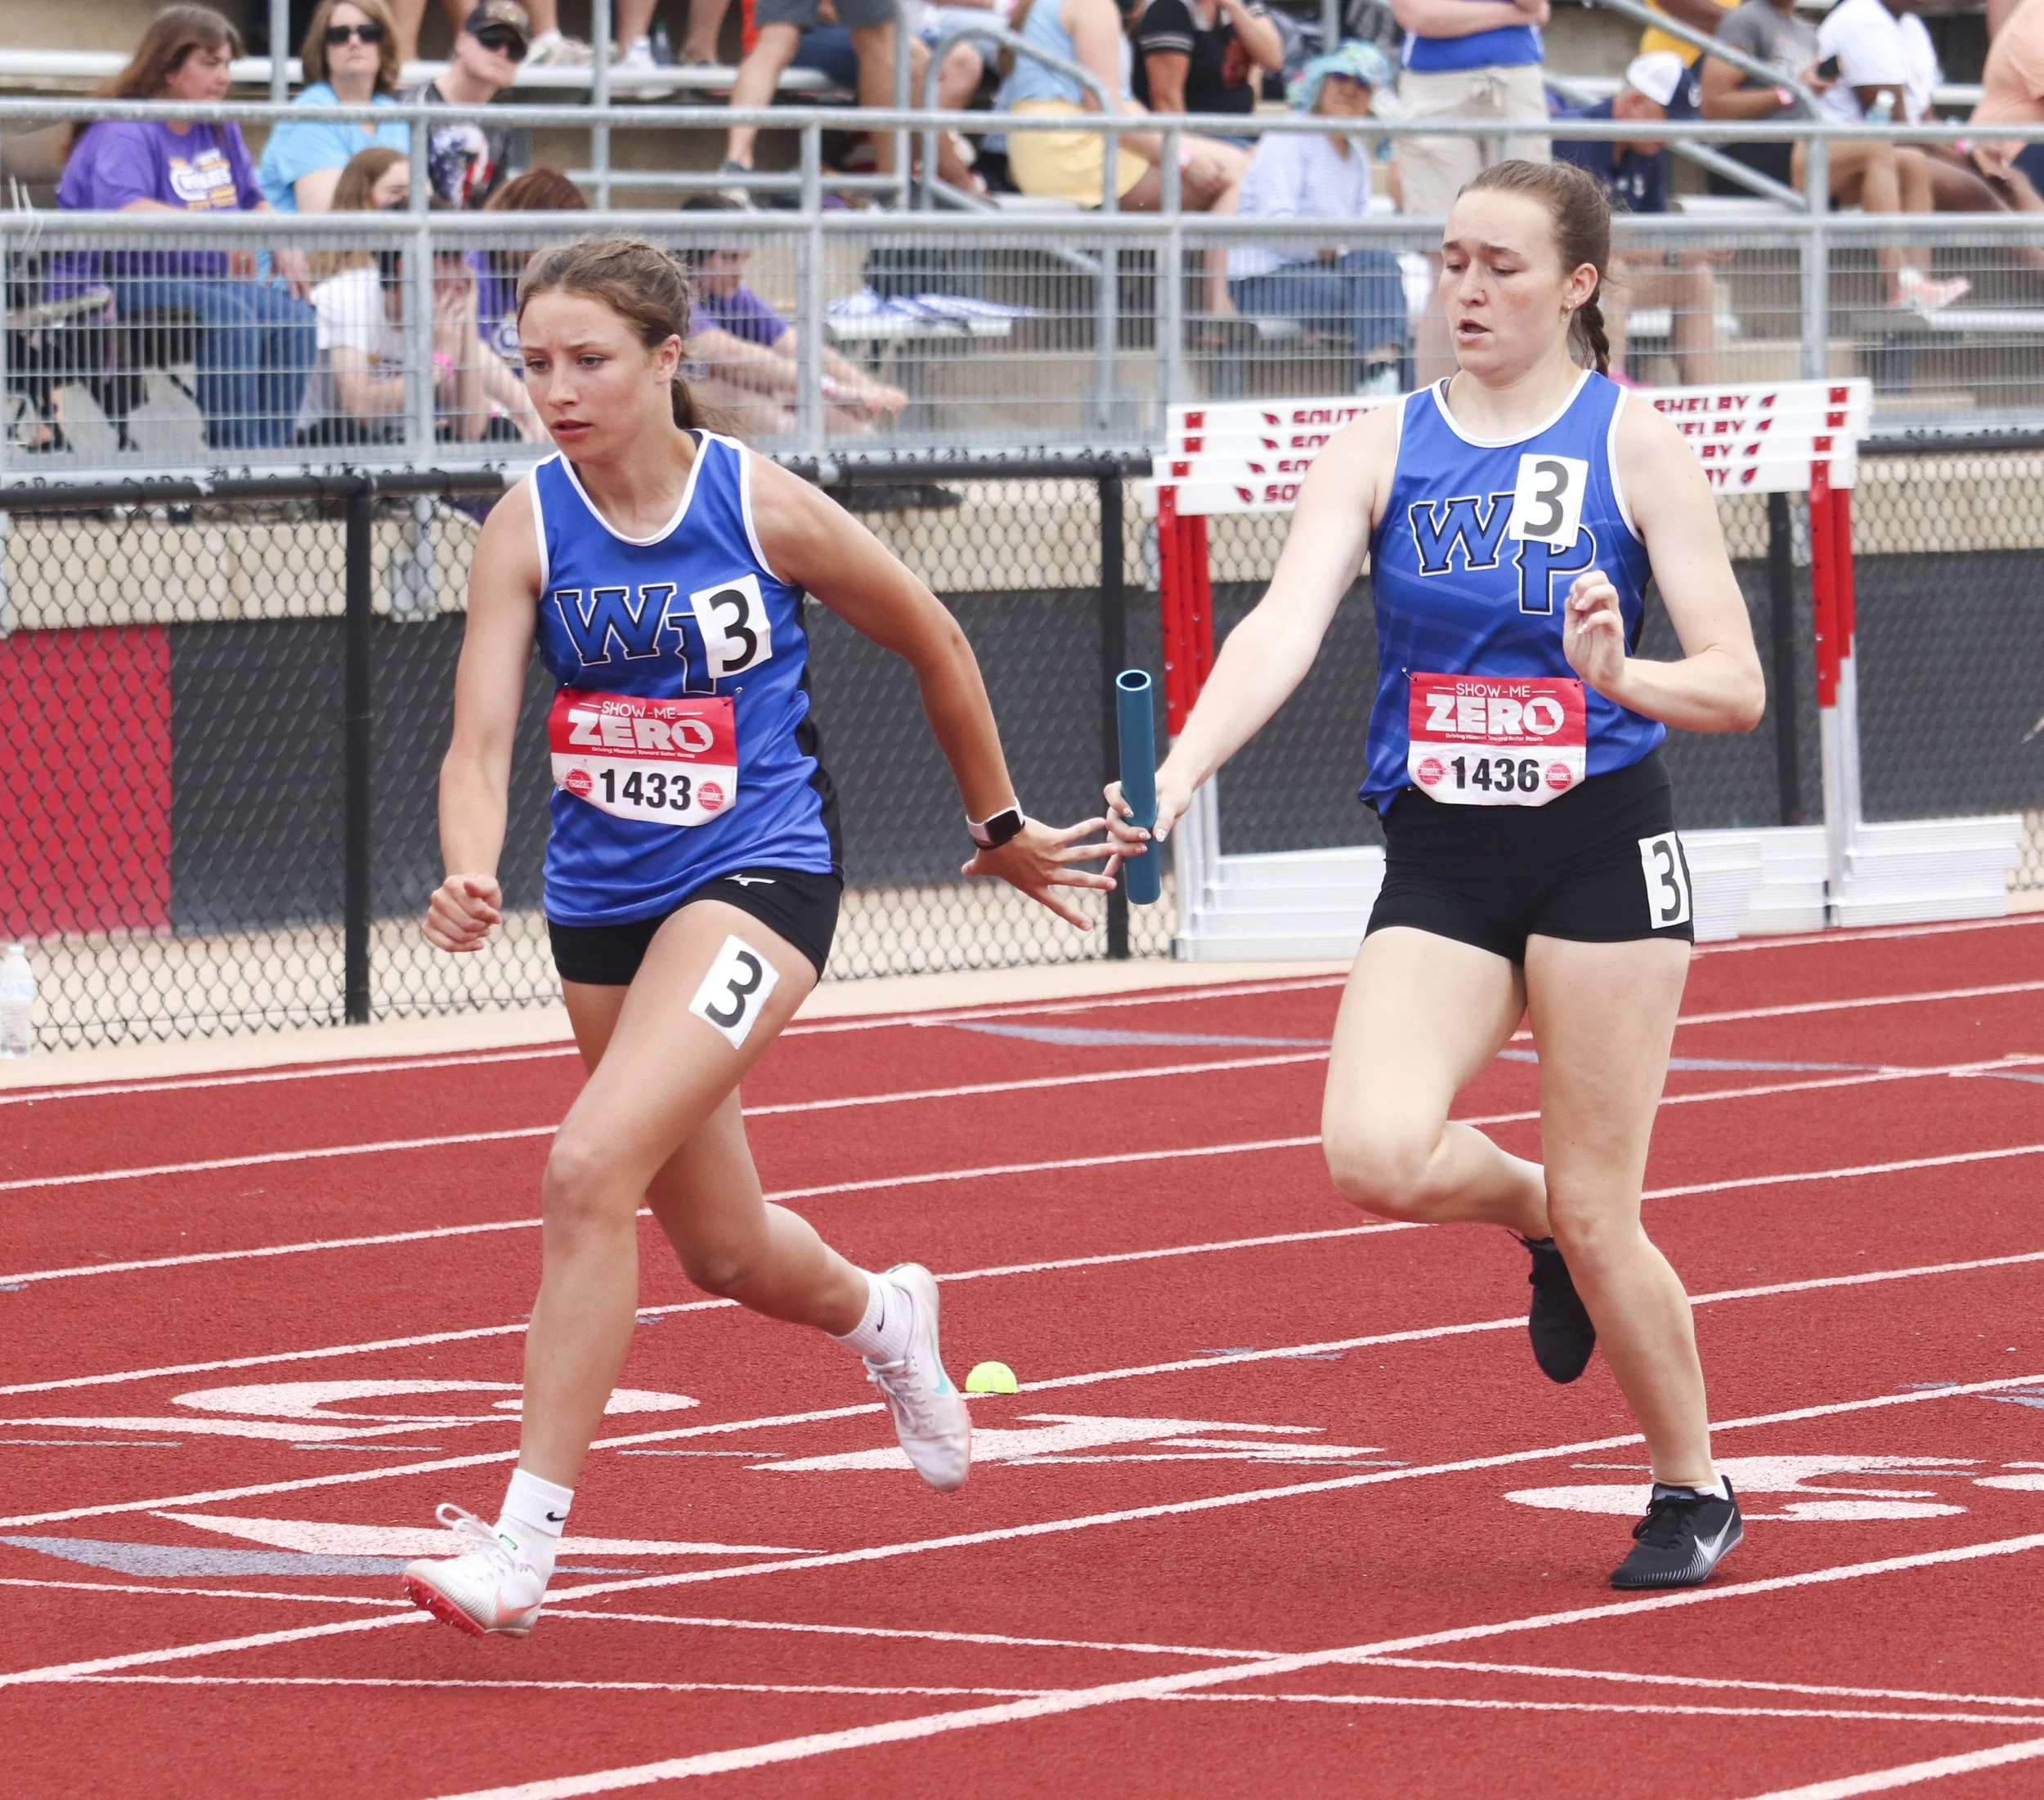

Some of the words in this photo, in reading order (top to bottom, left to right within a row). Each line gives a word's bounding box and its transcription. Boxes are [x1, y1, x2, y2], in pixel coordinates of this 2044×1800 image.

[1293, 408, 1378, 424] SOUT
[1652, 396, 1750, 413] SHELBY
[1676, 420, 1746, 436] ELBY
[1523, 460, 1569, 537] 3
[709, 589, 758, 673] 3
[601, 701, 676, 720] SHOW-ME
[1456, 683, 1531, 697] SHOW-ME
[567, 708, 715, 753] ZERO
[1426, 693, 1565, 736] ZERO
[600, 768, 692, 811] 1433
[1451, 756, 1540, 793] 1436
[1652, 840, 1682, 921] 3
[705, 950, 763, 1028] 3
